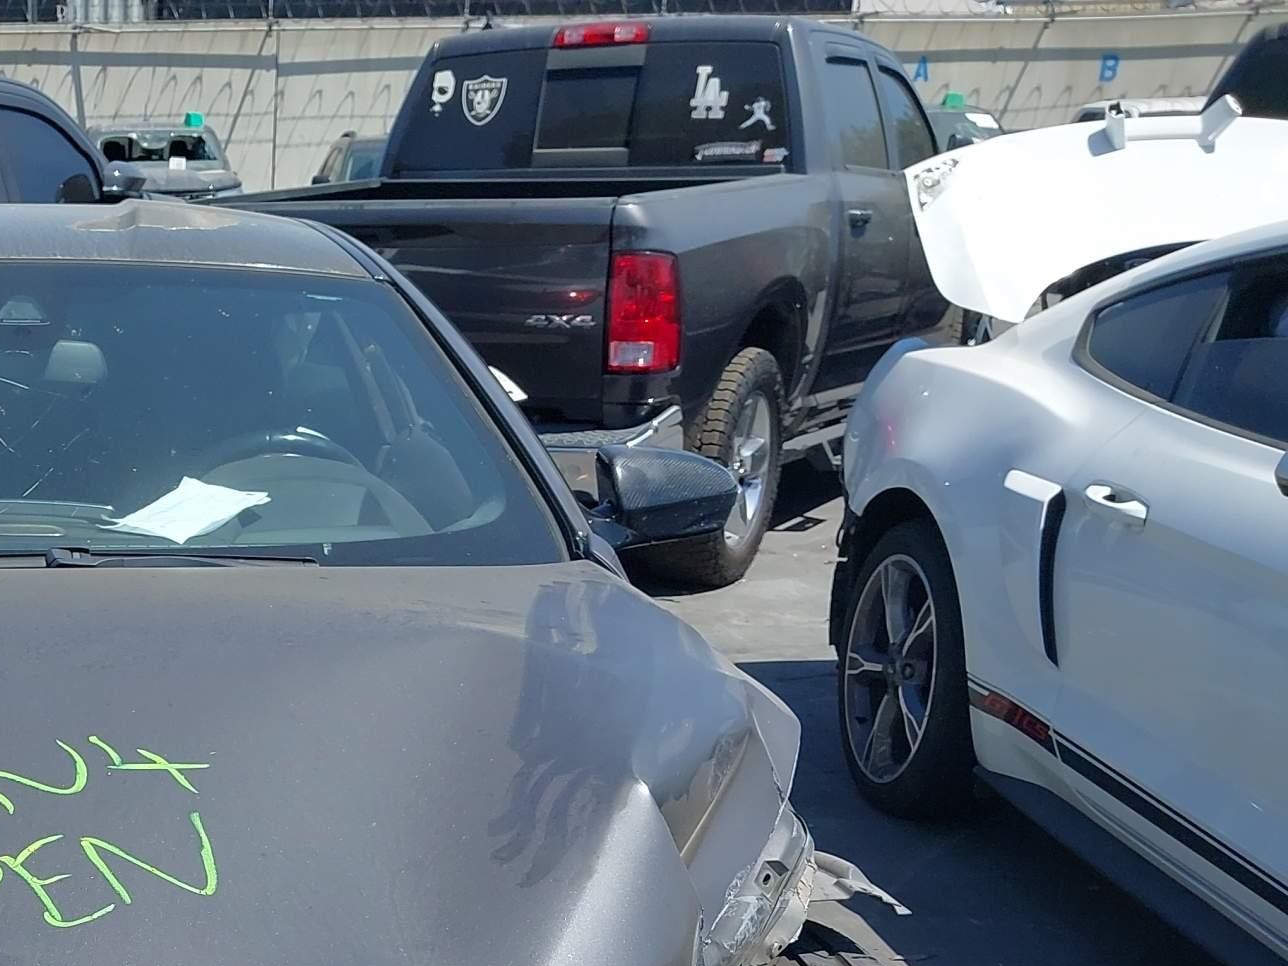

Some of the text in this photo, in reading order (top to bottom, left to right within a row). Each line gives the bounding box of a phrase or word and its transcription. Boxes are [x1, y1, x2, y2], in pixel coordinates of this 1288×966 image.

[913, 56, 929, 82] A
[1099, 55, 1121, 82] B
[690, 65, 729, 119] LA
